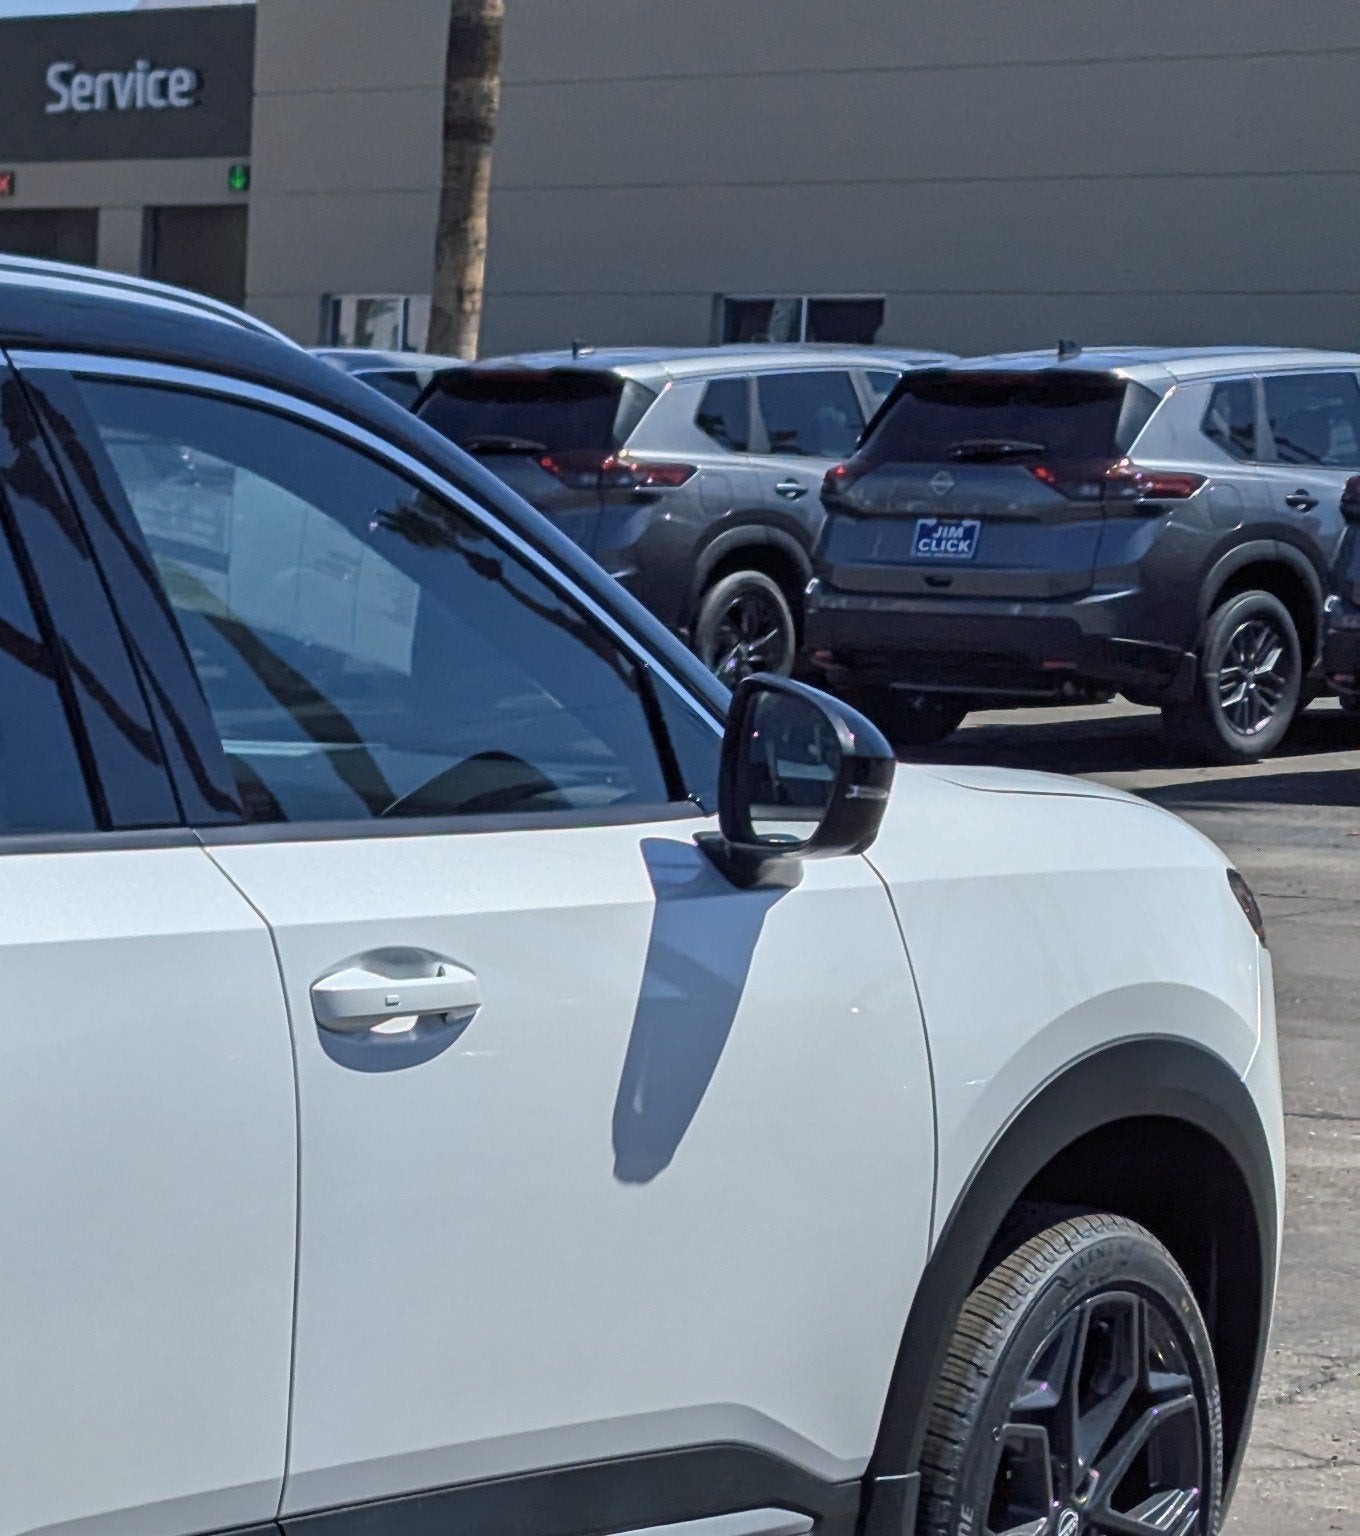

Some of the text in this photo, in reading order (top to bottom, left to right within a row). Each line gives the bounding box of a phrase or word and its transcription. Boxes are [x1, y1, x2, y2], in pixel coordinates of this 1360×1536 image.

[44, 59, 198, 114] Service
[932, 526, 964, 539] JIM
[918, 538, 971, 552] CLICK
